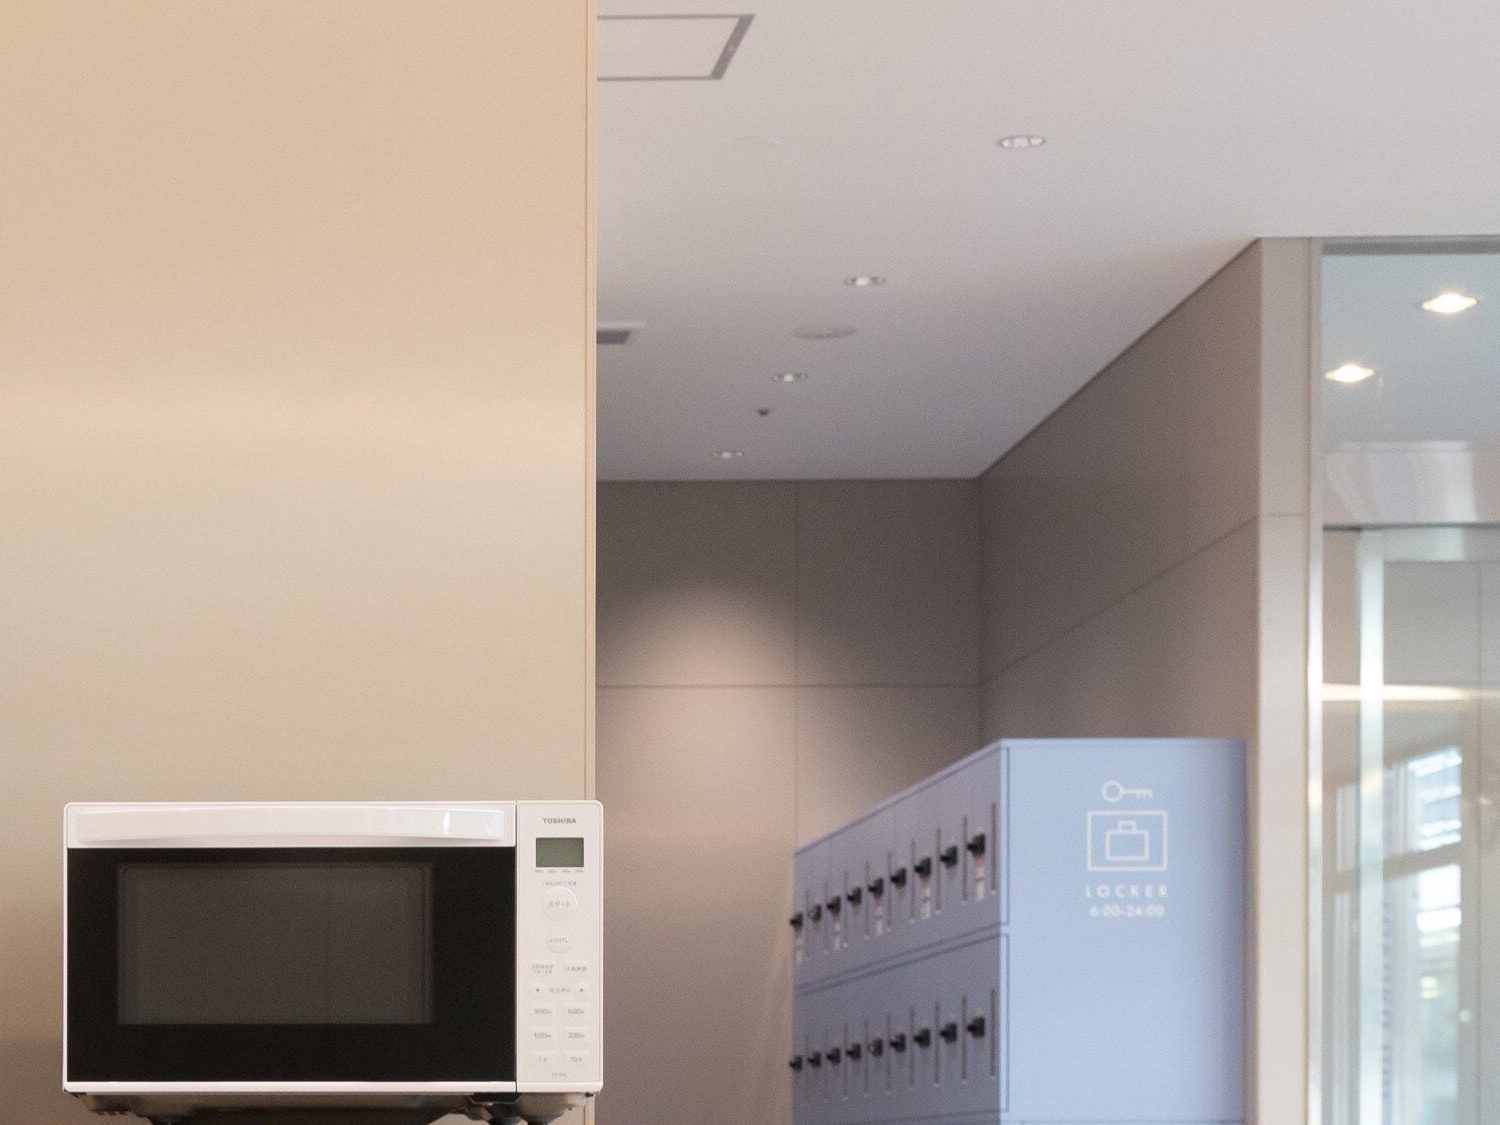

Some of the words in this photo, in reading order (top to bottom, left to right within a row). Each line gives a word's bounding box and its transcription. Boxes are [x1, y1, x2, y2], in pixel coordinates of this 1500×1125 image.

[1085, 884, 1168, 898] LOCKER
[548, 900, 571, 908] スタート
